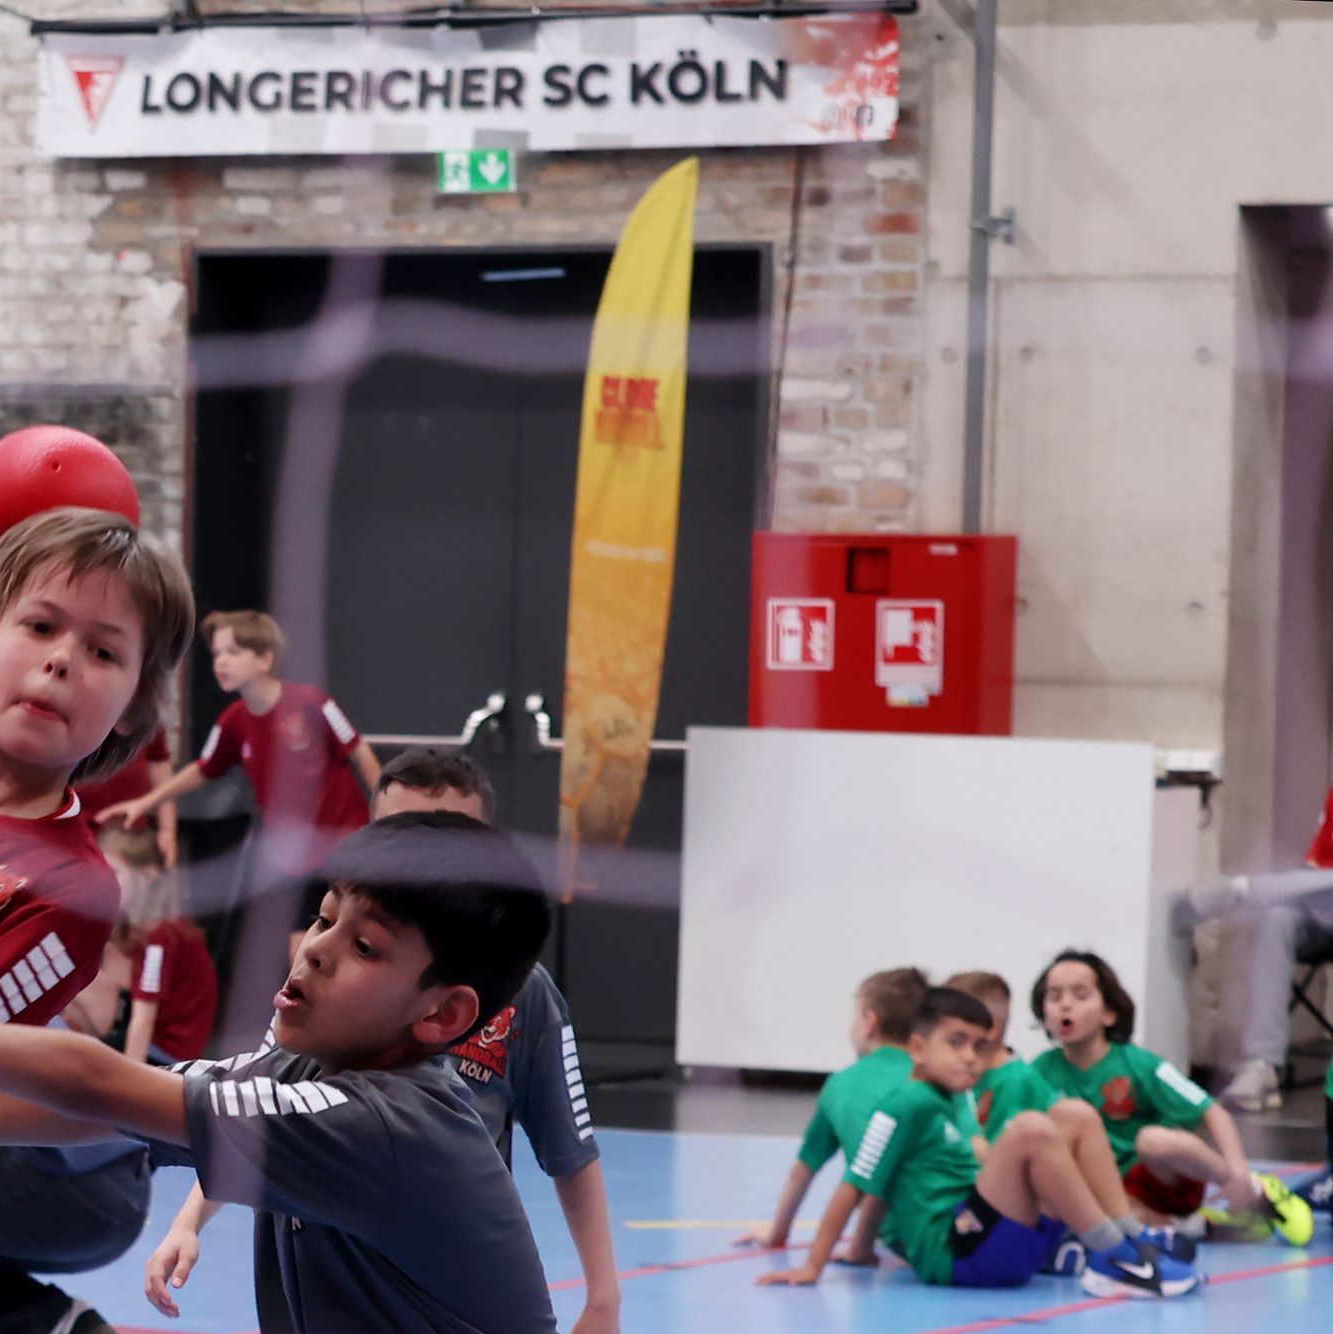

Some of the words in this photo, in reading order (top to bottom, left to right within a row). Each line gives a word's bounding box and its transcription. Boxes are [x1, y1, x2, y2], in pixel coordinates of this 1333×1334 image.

[140, 67, 525, 114] LONGERICHER
[544, 64, 611, 106] SC
[630, 49, 789, 105] KÖLN
[459, 1059, 492, 1083] KÖLN
